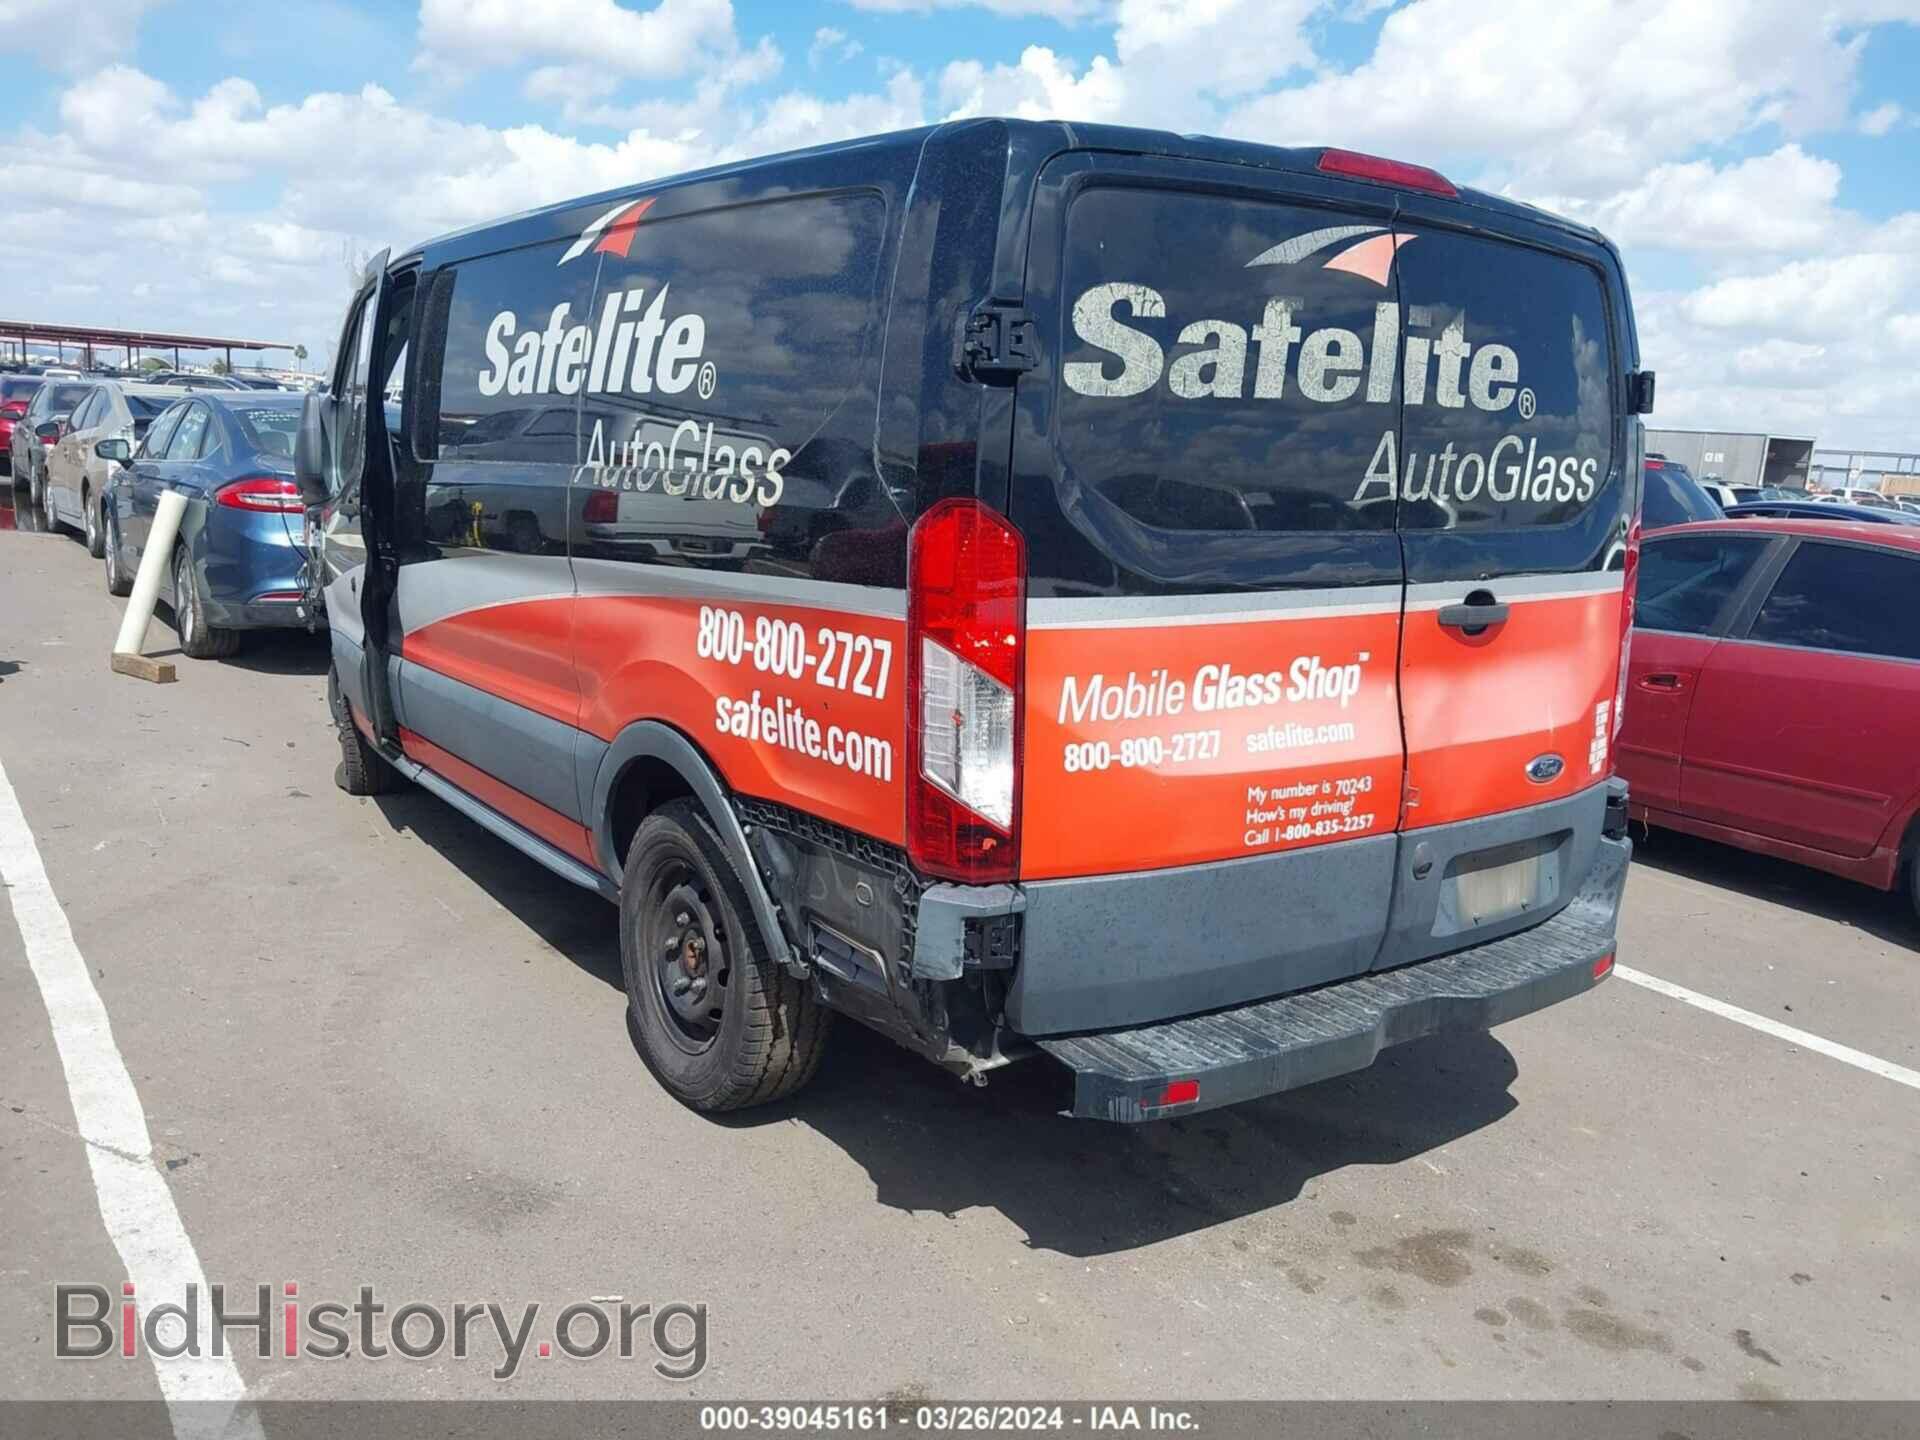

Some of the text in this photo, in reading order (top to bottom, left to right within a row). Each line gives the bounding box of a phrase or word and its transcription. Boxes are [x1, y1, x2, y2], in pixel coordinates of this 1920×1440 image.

[574, 419, 792, 507] AutoGlass
[1354, 430, 1598, 502] AutoGlass
[697, 606, 892, 700] 800-800-2727
[1057, 670, 1186, 725] Mobile
[1192, 663, 1281, 712] Glass
[715, 690, 892, 782] safelite.com
[1064, 730, 1222, 773] 800-800-2727
[1246, 721, 1354, 753] safelite.com
[1246, 795, 1355, 824] How's my driving?
[1247, 776, 1372, 805] My number is 70243
[1244, 828, 1270, 846] Call
